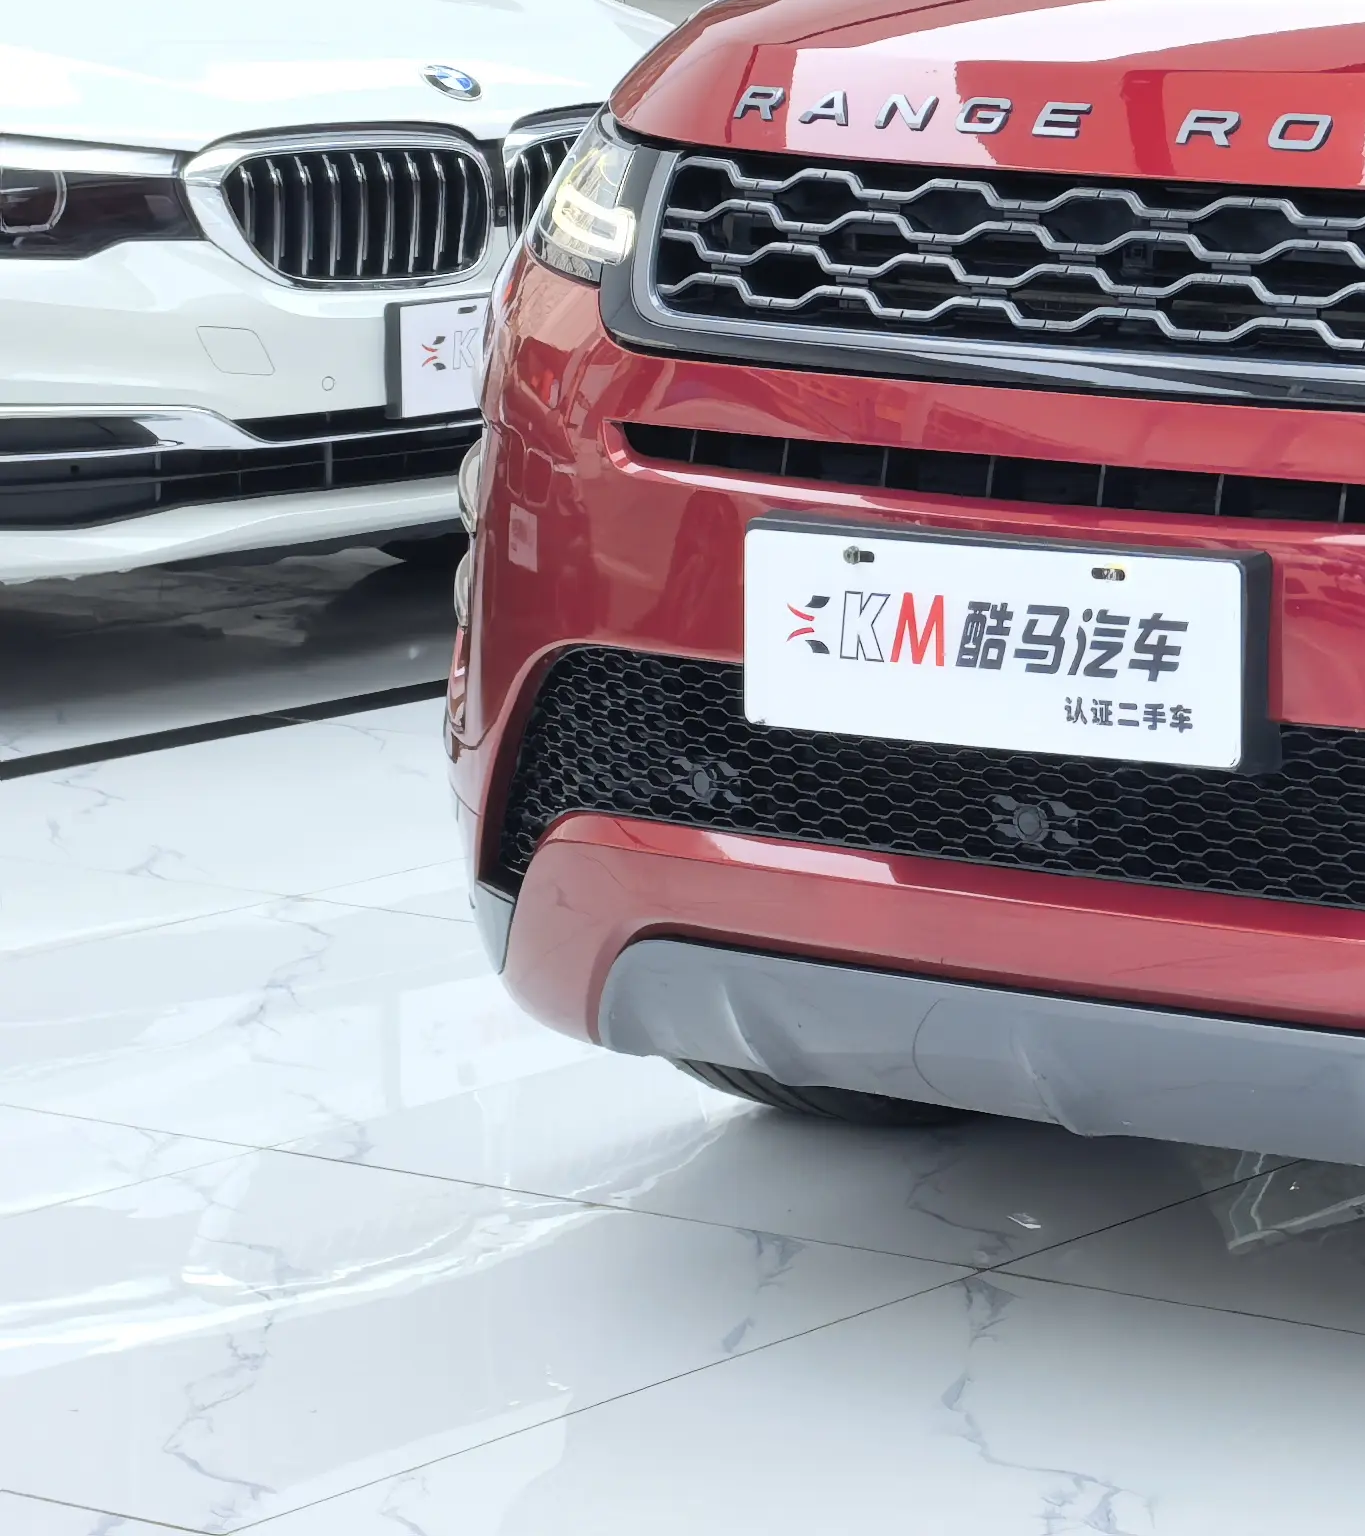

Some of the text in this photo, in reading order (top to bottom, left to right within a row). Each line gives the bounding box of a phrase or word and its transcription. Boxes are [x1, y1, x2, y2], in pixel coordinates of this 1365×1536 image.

[732, 84, 1093, 140] RANGE
[839, 590, 1190, 682] KM 酷马汽车
[1063, 695, 1195, 734] 认证二手车
